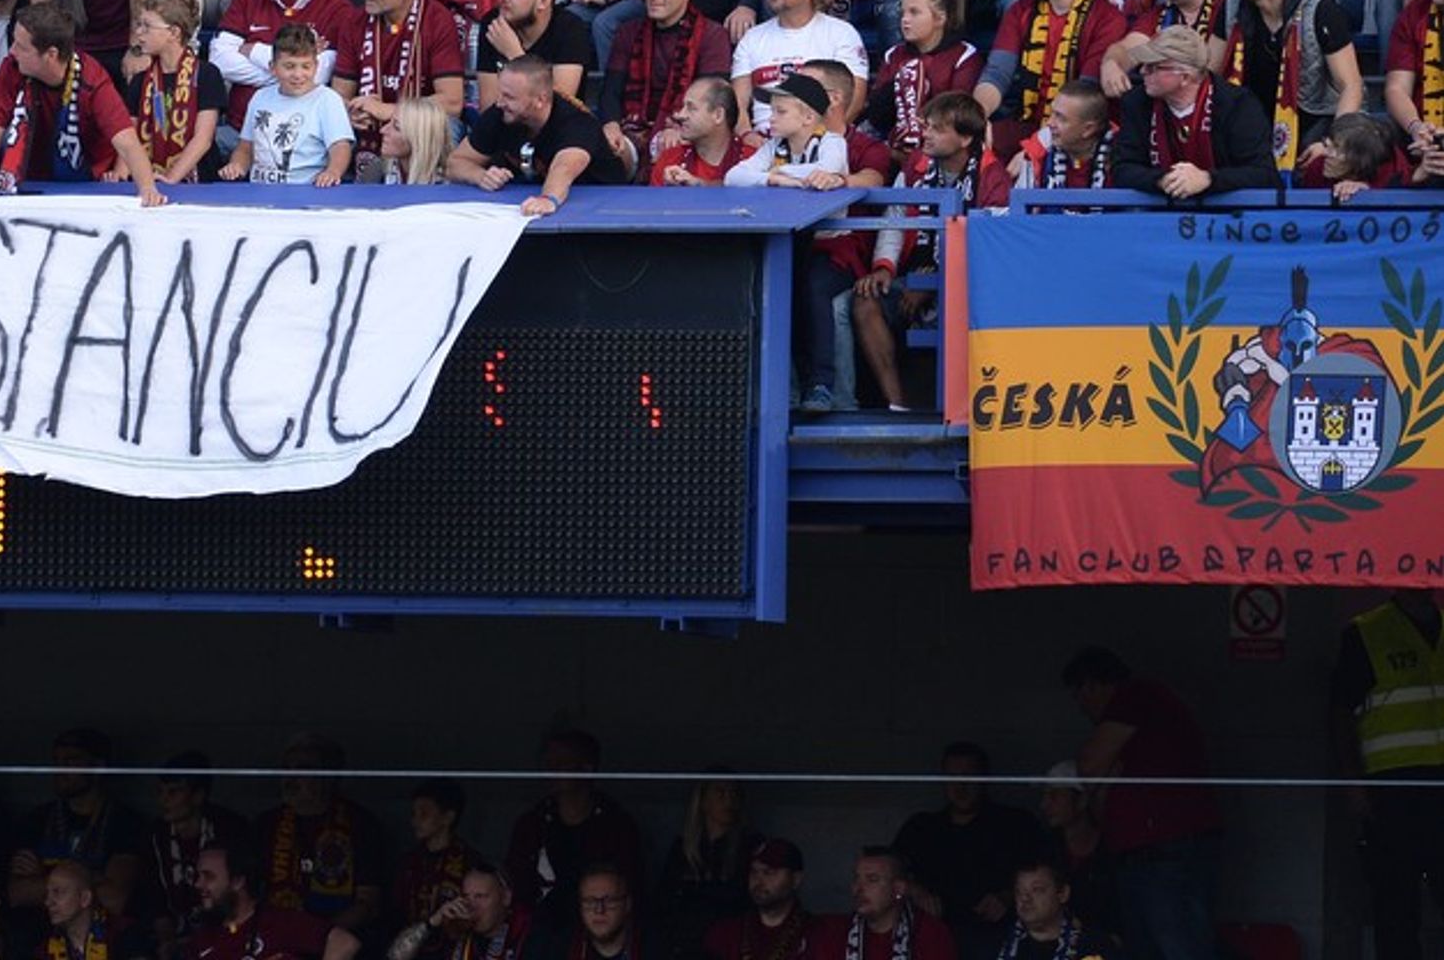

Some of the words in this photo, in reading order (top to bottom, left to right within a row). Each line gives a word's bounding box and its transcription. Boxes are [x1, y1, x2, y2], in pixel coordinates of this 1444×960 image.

[972, 365, 1137, 431] ČESKÁ
[987, 547, 1057, 574] FAN
[1078, 545, 1182, 574] CLUB
